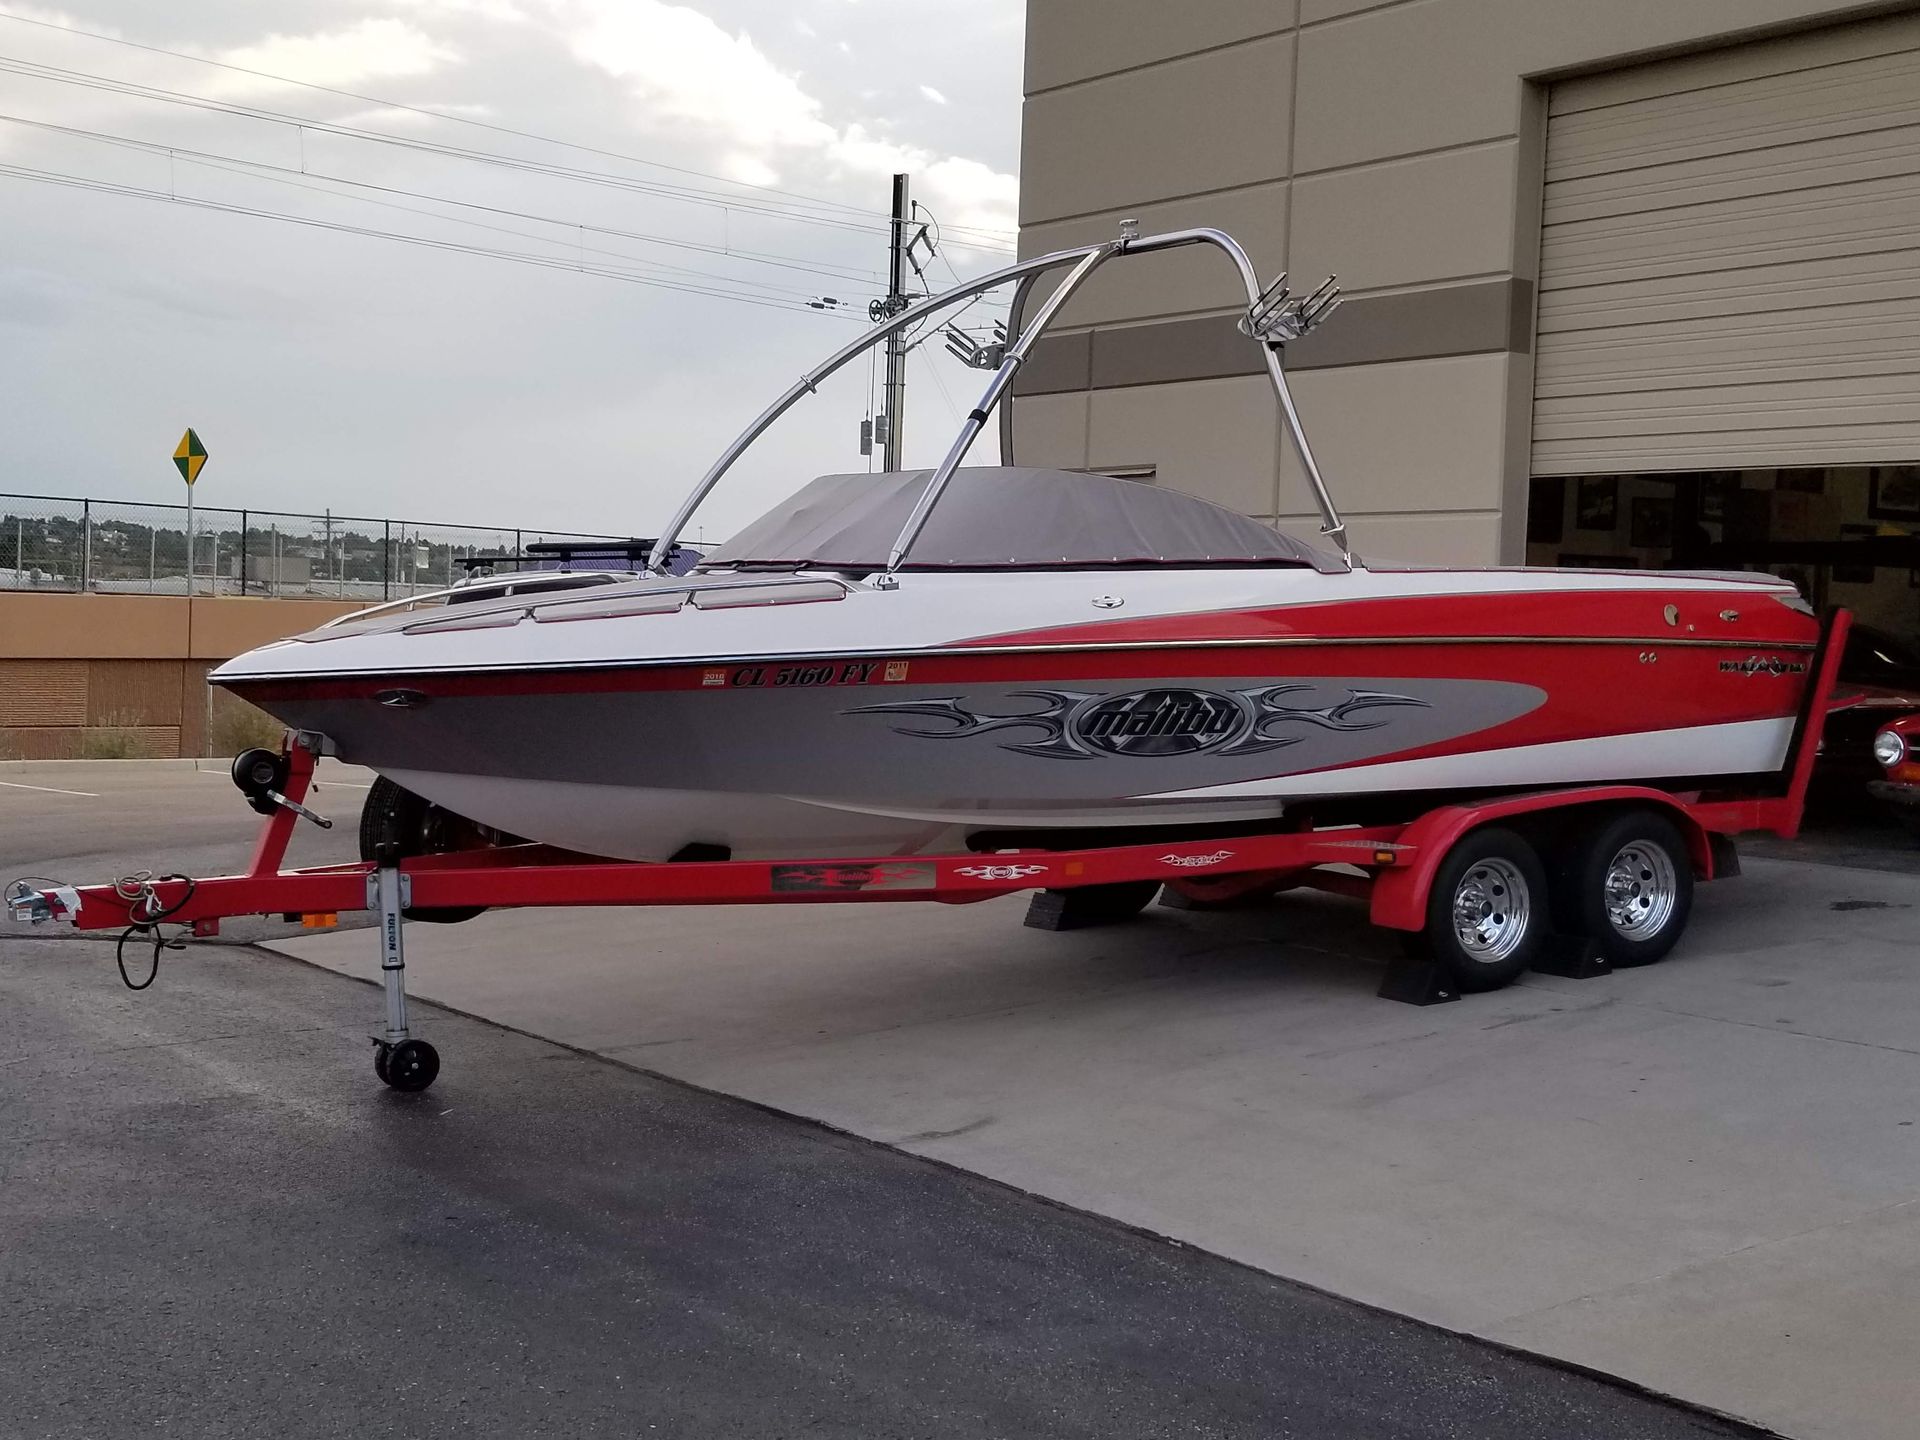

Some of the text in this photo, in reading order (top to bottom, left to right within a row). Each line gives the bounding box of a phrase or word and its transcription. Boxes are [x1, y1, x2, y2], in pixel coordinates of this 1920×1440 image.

[732, 663, 879, 686] CL 5160 FY
[387, 912, 397, 951] FULTON
